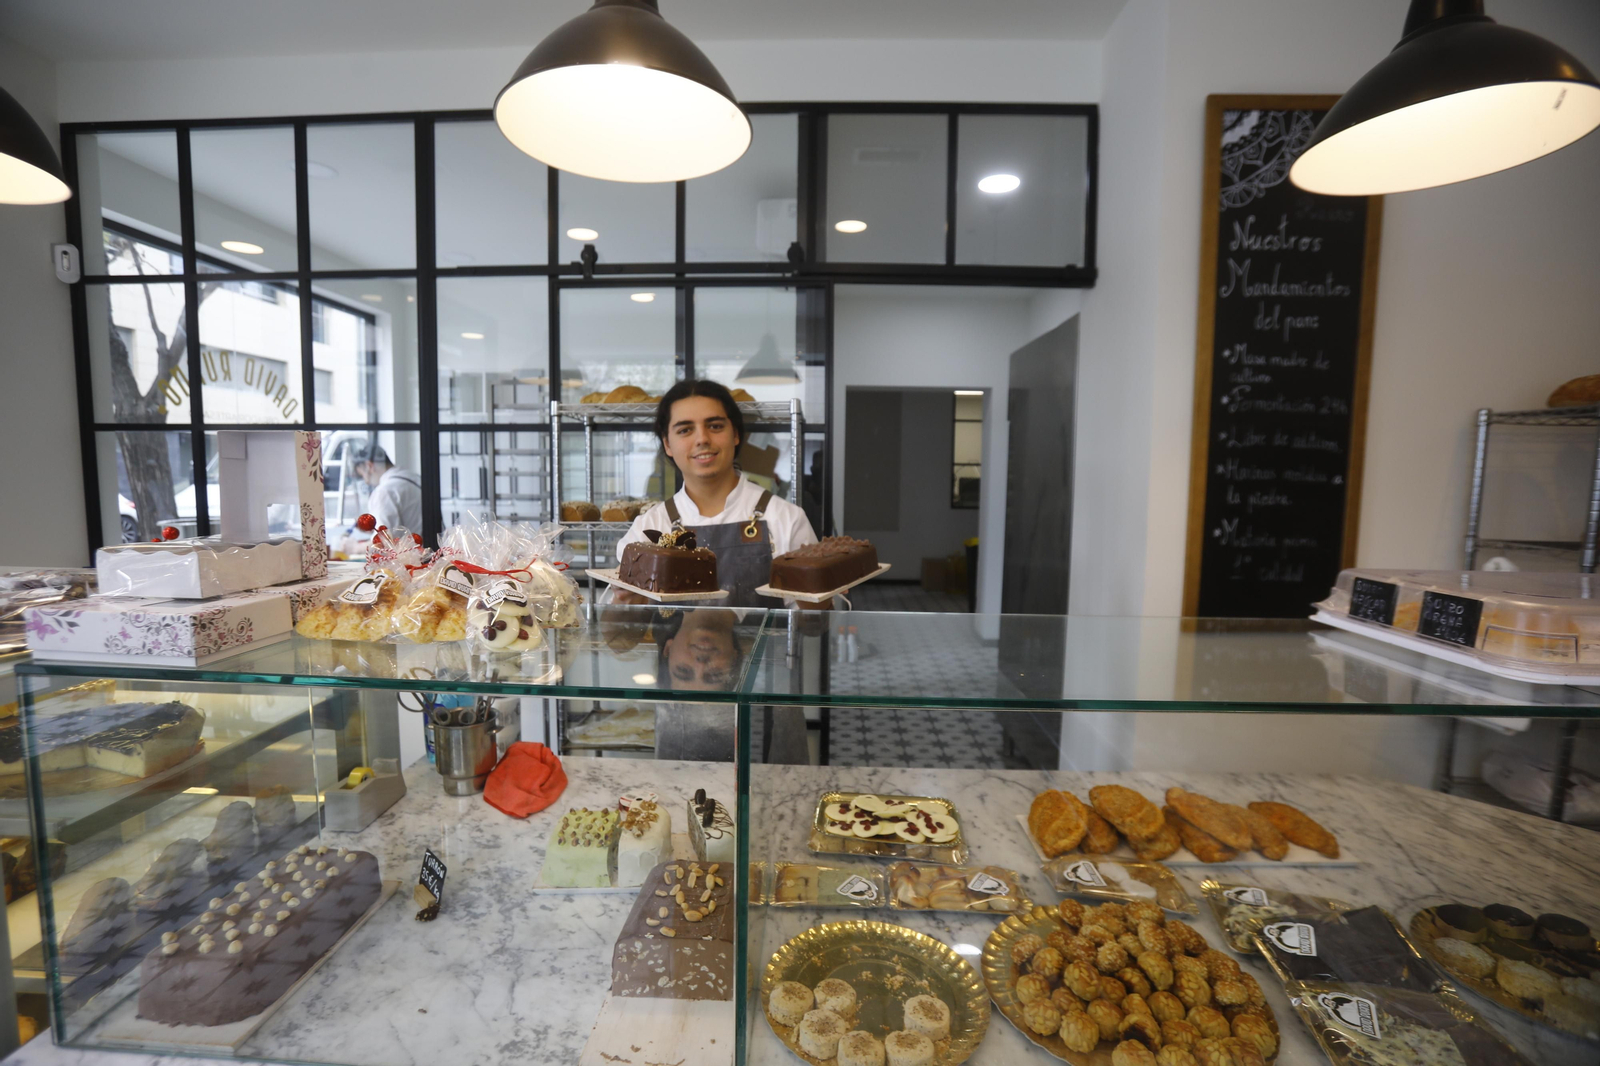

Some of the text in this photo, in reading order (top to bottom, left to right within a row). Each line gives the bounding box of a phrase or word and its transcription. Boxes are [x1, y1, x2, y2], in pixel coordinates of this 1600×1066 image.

[1229, 214, 1324, 252] Nuestros
[1219, 257, 1352, 298] Mandamientos
[1253, 300, 1281, 330] del
